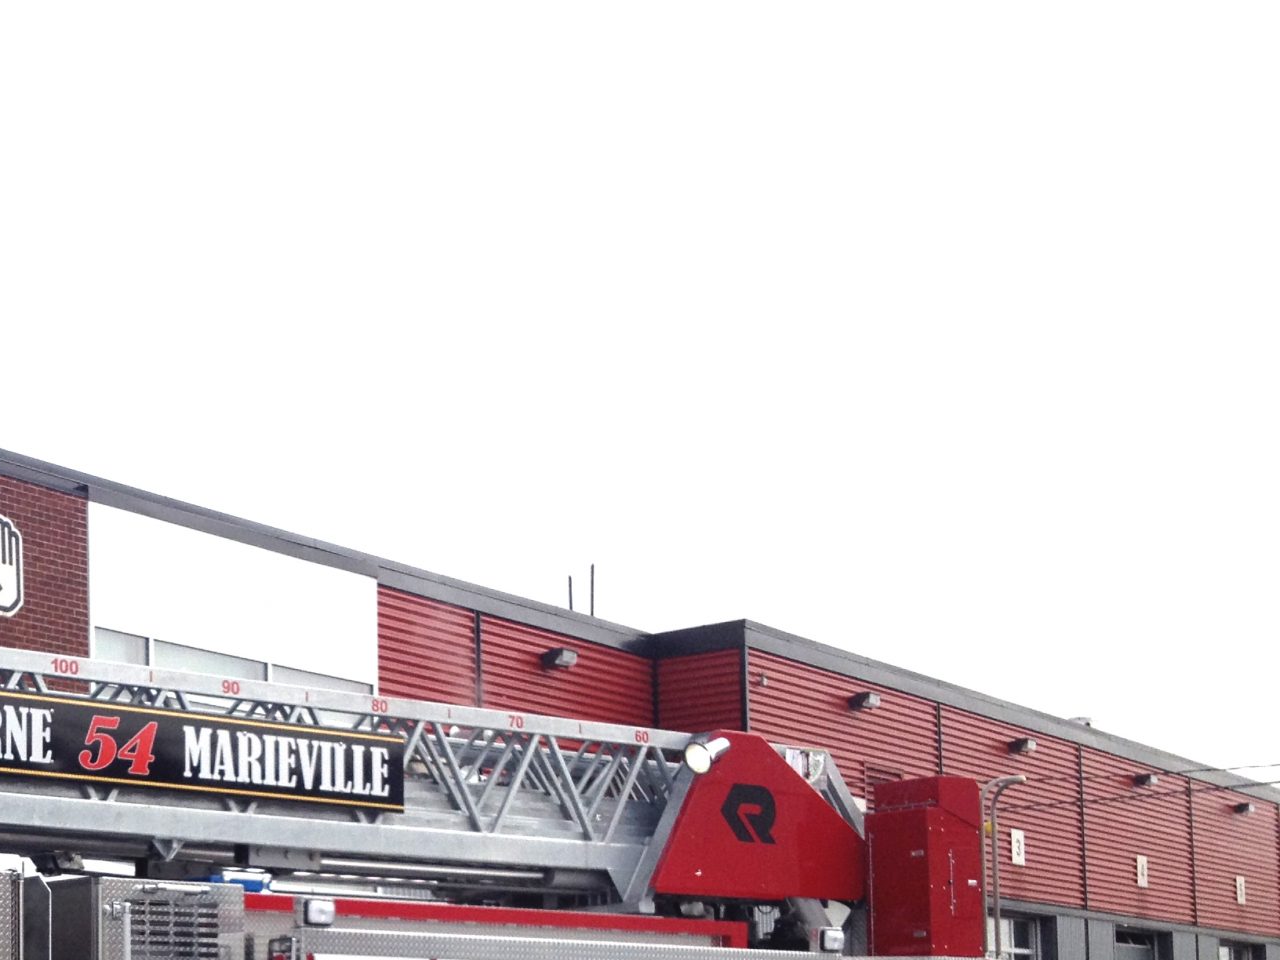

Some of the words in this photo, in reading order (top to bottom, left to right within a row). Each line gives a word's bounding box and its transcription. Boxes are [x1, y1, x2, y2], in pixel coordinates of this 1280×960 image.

[51, 658, 79, 676] 100
[221, 680, 240, 695] 90
[371, 700, 388, 713] 80
[508, 715, 524, 729] 70
[634, 730, 649, 744] 60
[78, 714, 159, 776] 54
[183, 725, 390, 797] MARIEVILLE
